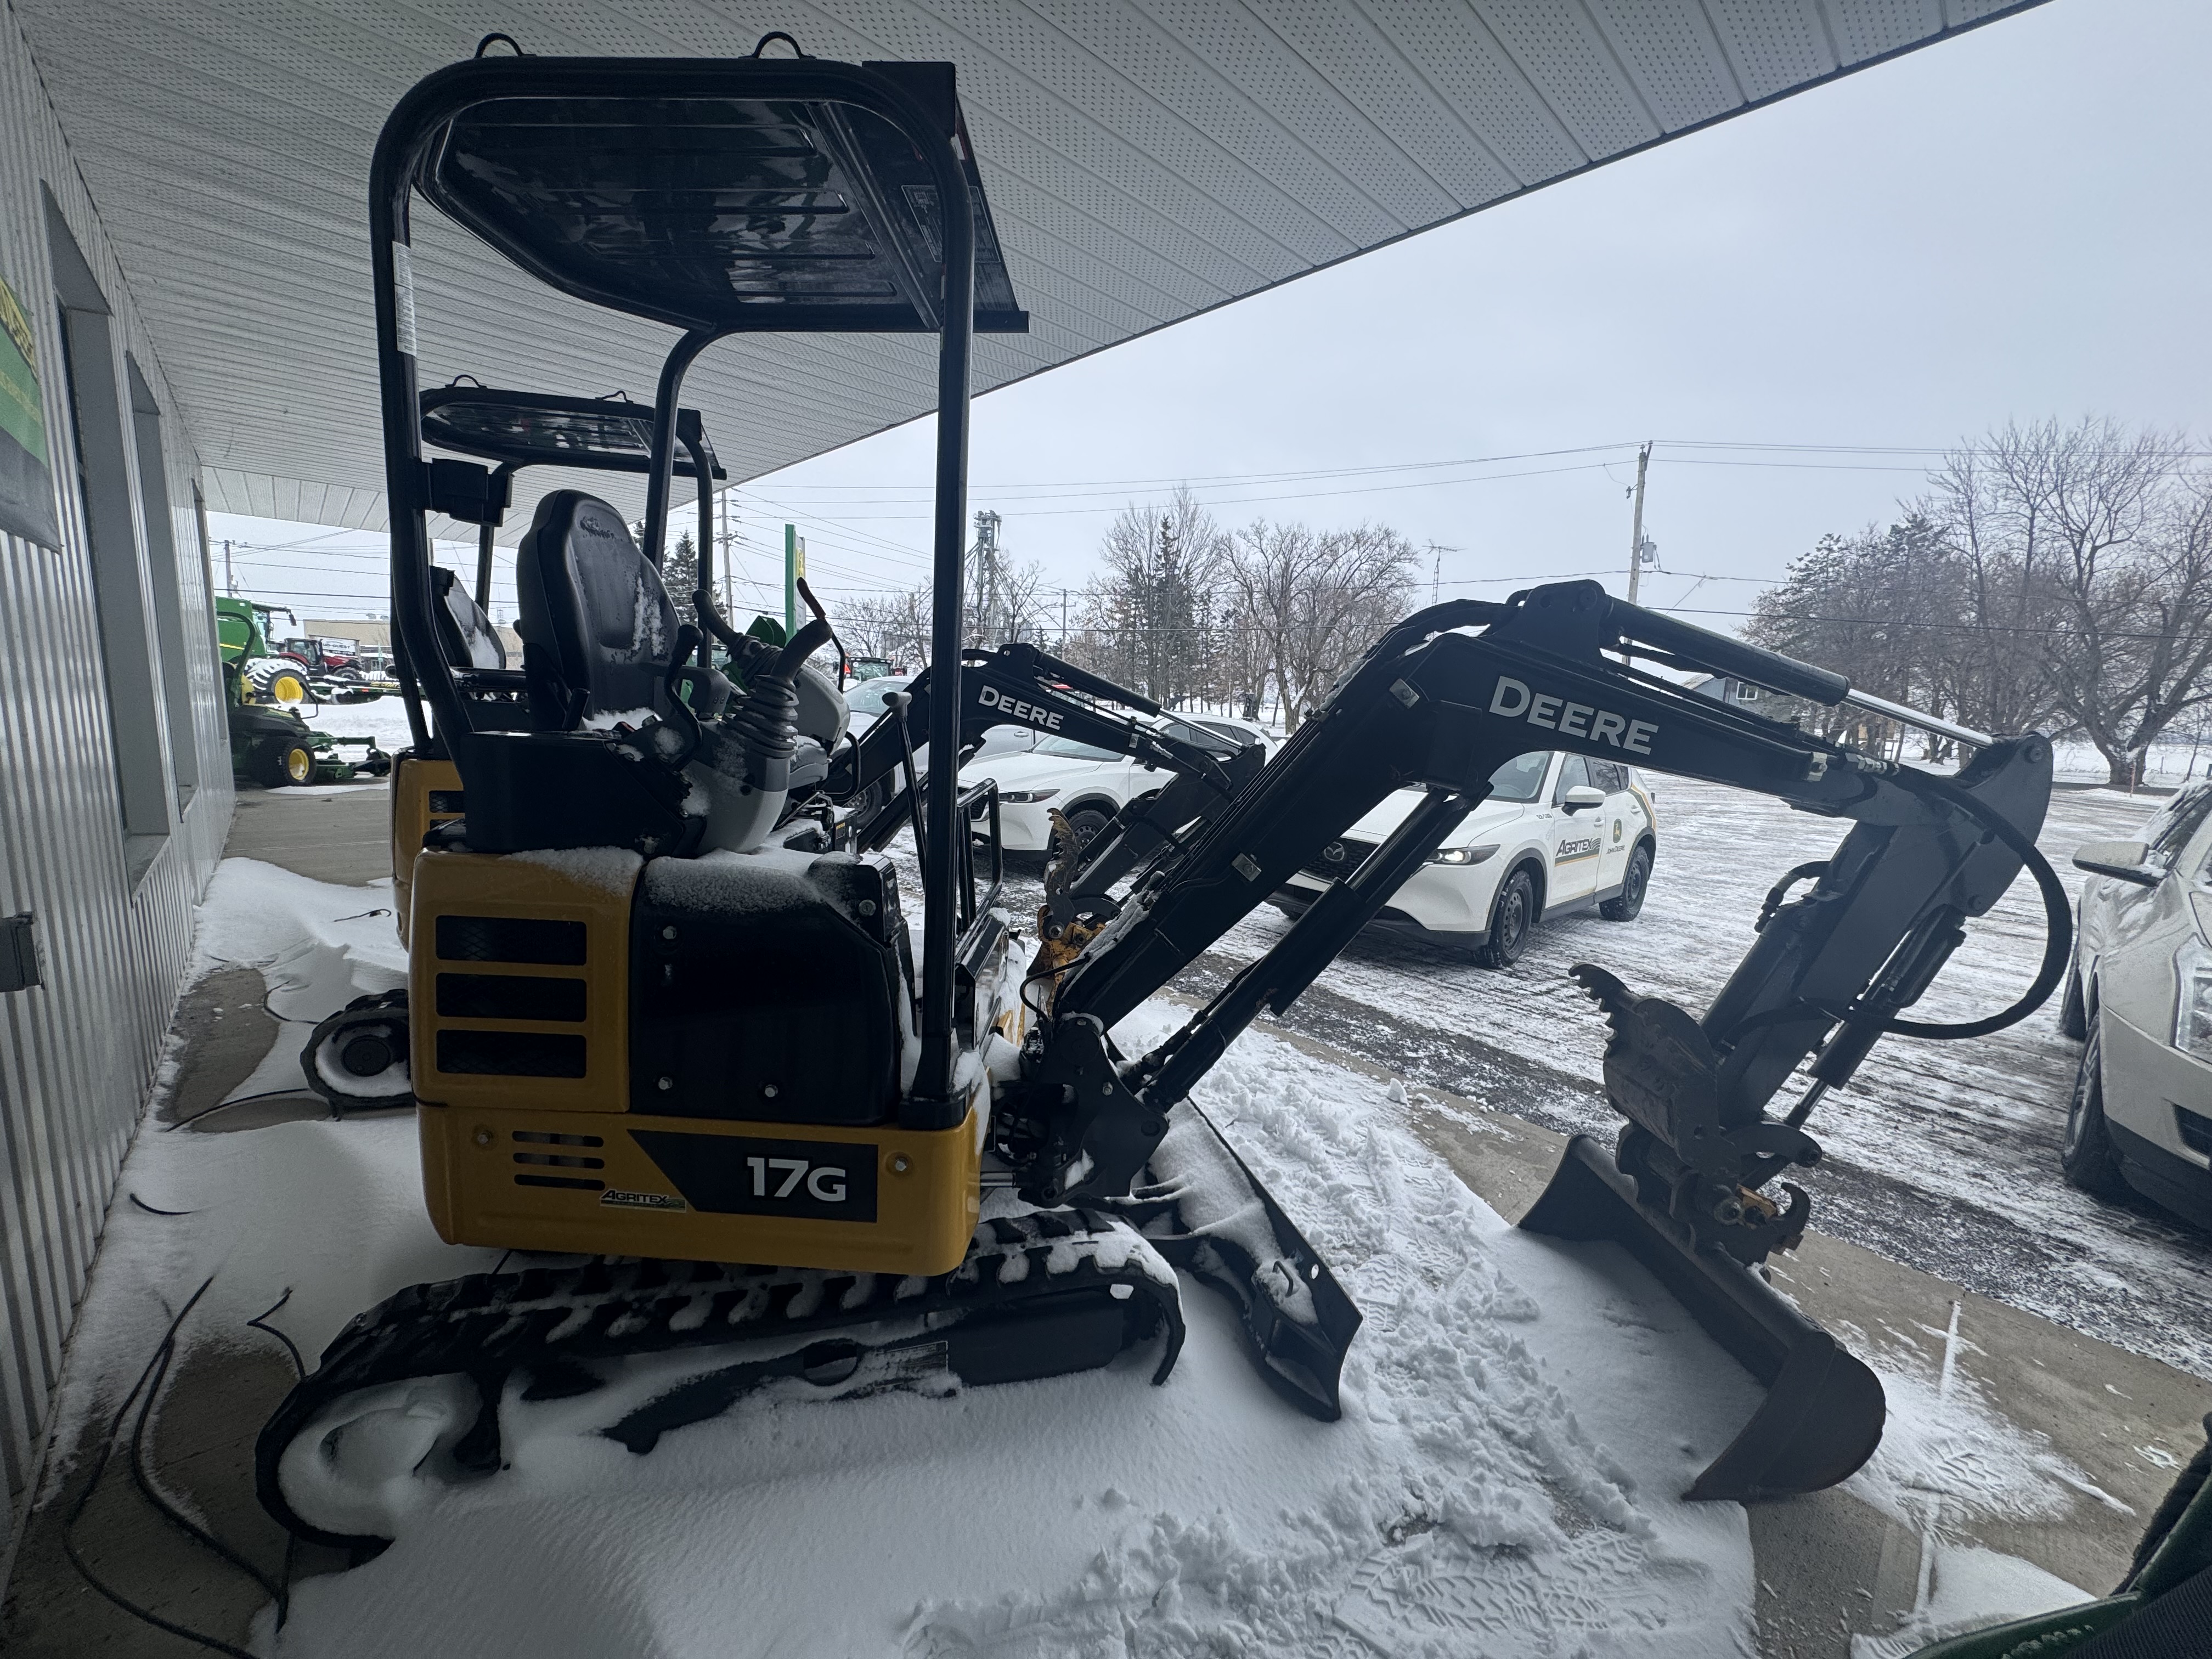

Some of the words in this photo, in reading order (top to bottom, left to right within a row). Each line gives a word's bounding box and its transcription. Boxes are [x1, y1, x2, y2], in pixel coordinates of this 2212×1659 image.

[978, 685, 1064, 731] DEERE
[1488, 675, 1660, 755] DEERE
[1555, 838, 1593, 857] AGRITEX
[601, 1189, 668, 1204] AGRITEX
[747, 1156, 846, 1201] 17G
